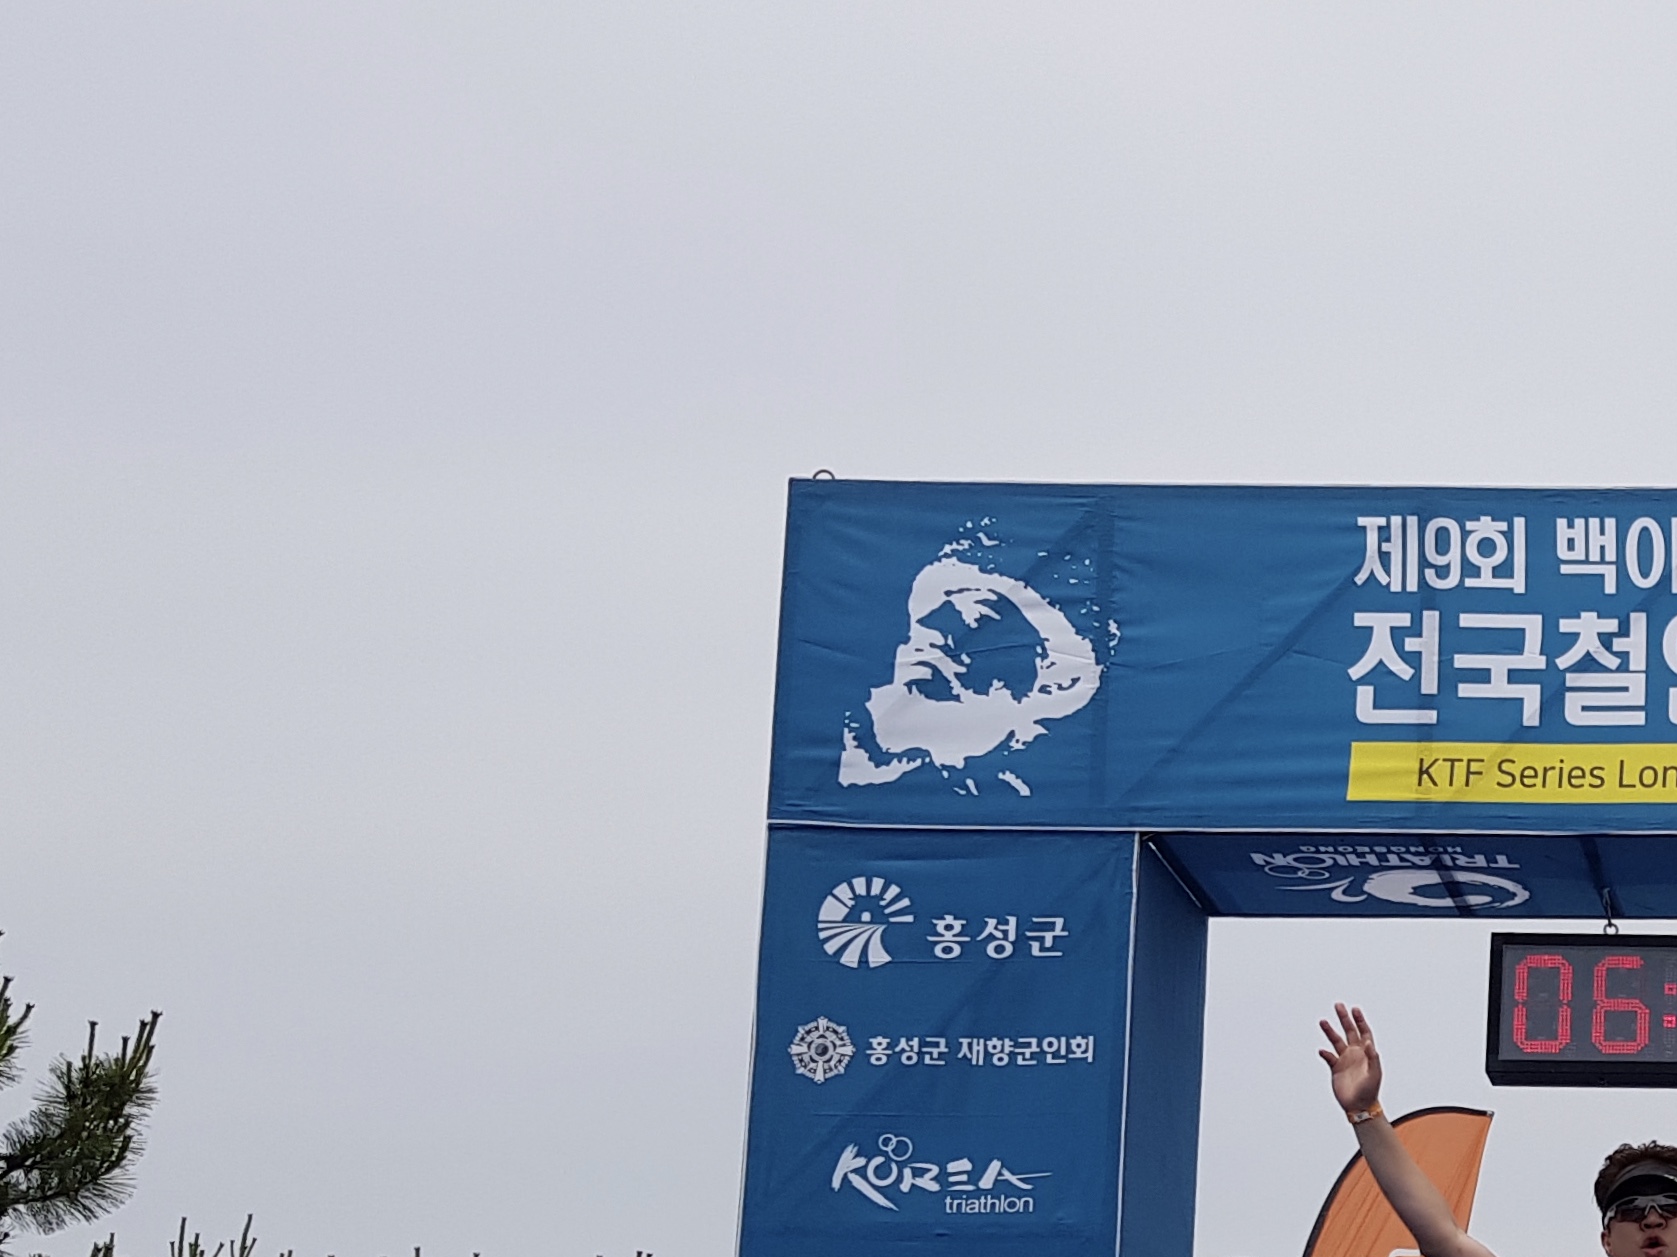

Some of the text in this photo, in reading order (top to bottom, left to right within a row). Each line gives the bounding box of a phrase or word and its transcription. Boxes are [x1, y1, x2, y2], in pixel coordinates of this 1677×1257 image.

[1354, 514, 1527, 594] 제9회
[1416, 757, 1484, 790] KTF
[1495, 756, 1607, 791] Series
[1249, 851, 1521, 870] TRIATHLON
[926, 914, 1070, 960] 홍성군
[866, 1034, 1095, 1067] 홍성군 재향군인회
[944, 1195, 1034, 1214] triathlon
